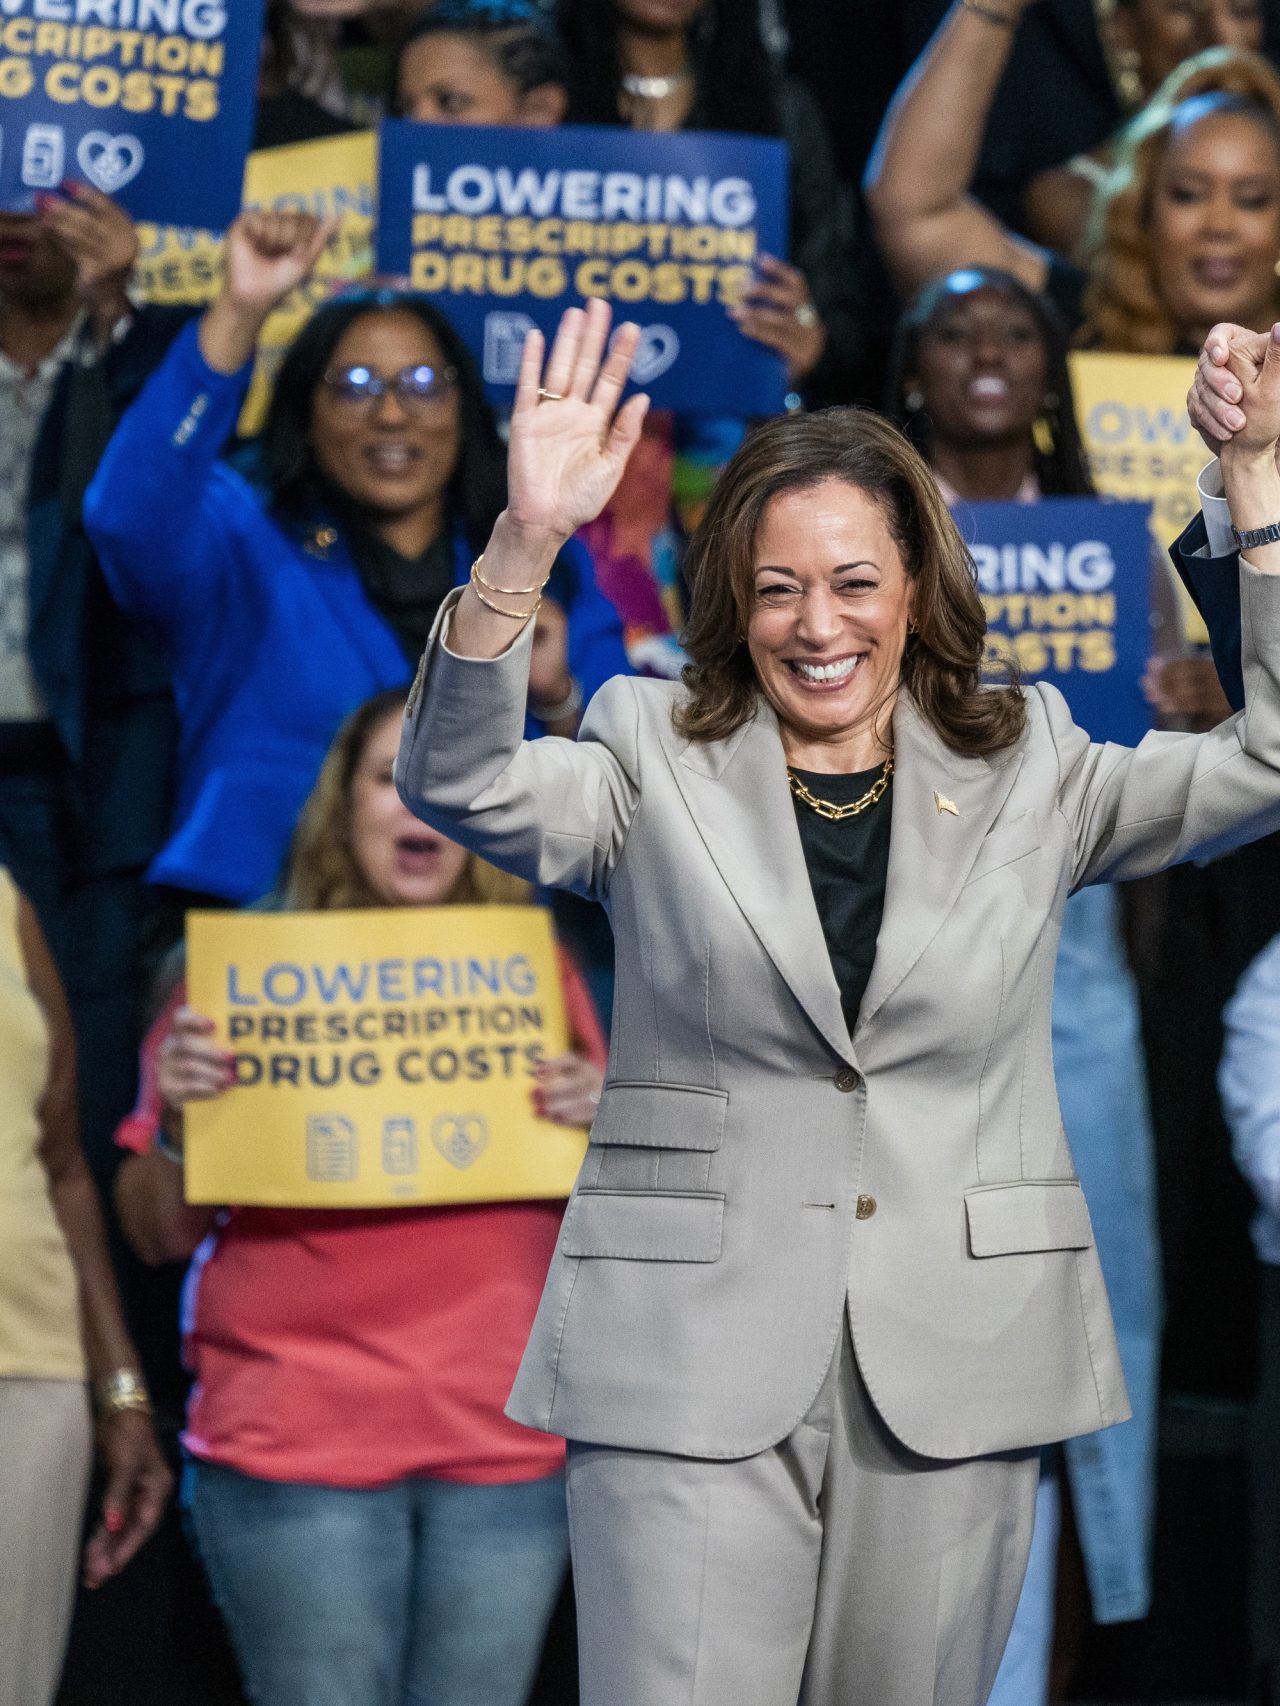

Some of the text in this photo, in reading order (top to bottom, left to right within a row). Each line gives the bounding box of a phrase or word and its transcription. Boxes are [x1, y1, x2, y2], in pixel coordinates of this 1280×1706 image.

[0, 15, 225, 77] CRIPTION
[44, 61, 220, 121] COSTS
[412, 163, 758, 226] LOWERING
[412, 214, 758, 260] PRESCRIPTION
[410, 251, 568, 298] DRUG
[968, 540, 1116, 592] RING
[226, 954, 538, 1007] LOWERING
[228, 1005, 544, 1044] PRESCRIPTION
[234, 1042, 546, 1088] DRUG COSTS
